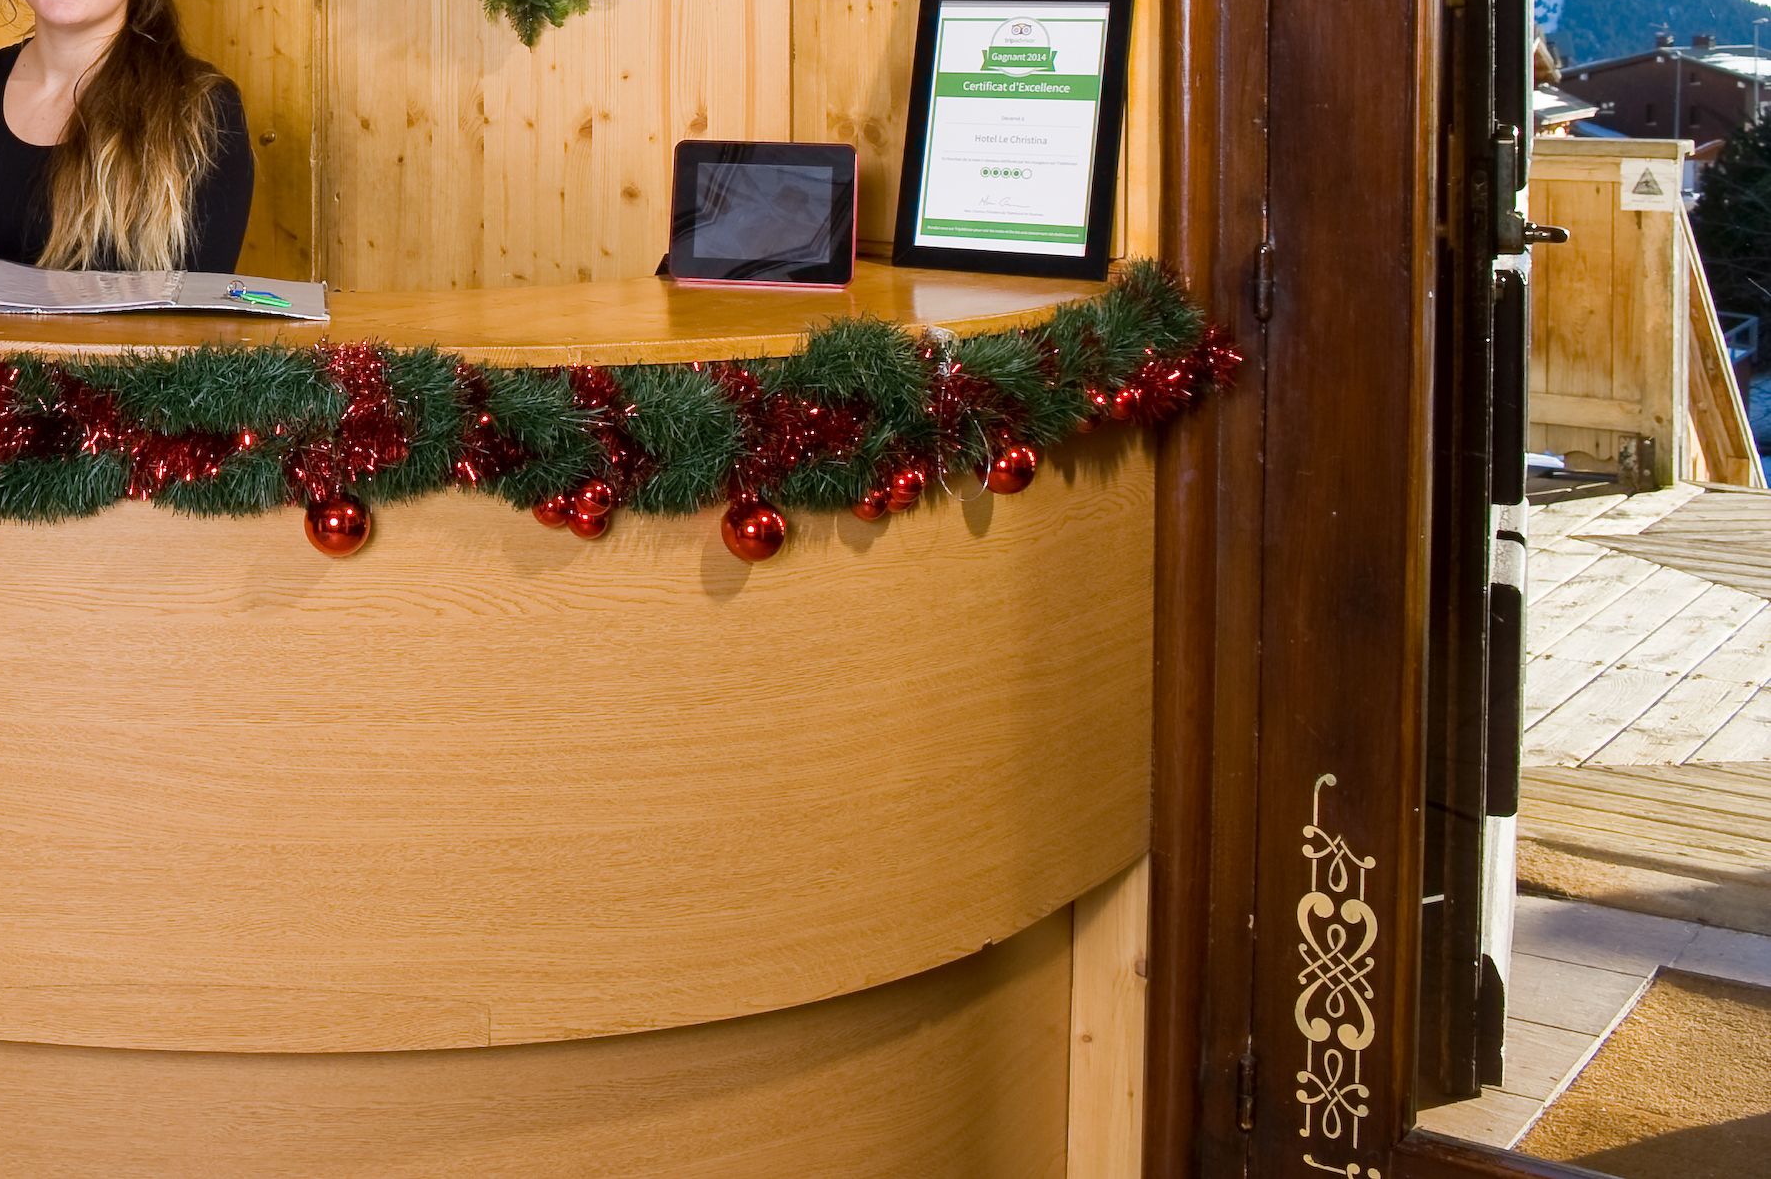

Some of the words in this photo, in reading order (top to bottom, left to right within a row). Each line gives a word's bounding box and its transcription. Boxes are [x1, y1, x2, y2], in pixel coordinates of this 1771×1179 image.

[991, 52, 1026, 63] Gagnant
[1026, 52, 1047, 62] 2014
[962, 80, 1008, 92] Certificat
[1009, 82, 1071, 94] d'Excellence
[974, 134, 998, 144] Hotel
[999, 135, 1009, 144] Le
[1009, 135, 1048, 145] Christina
